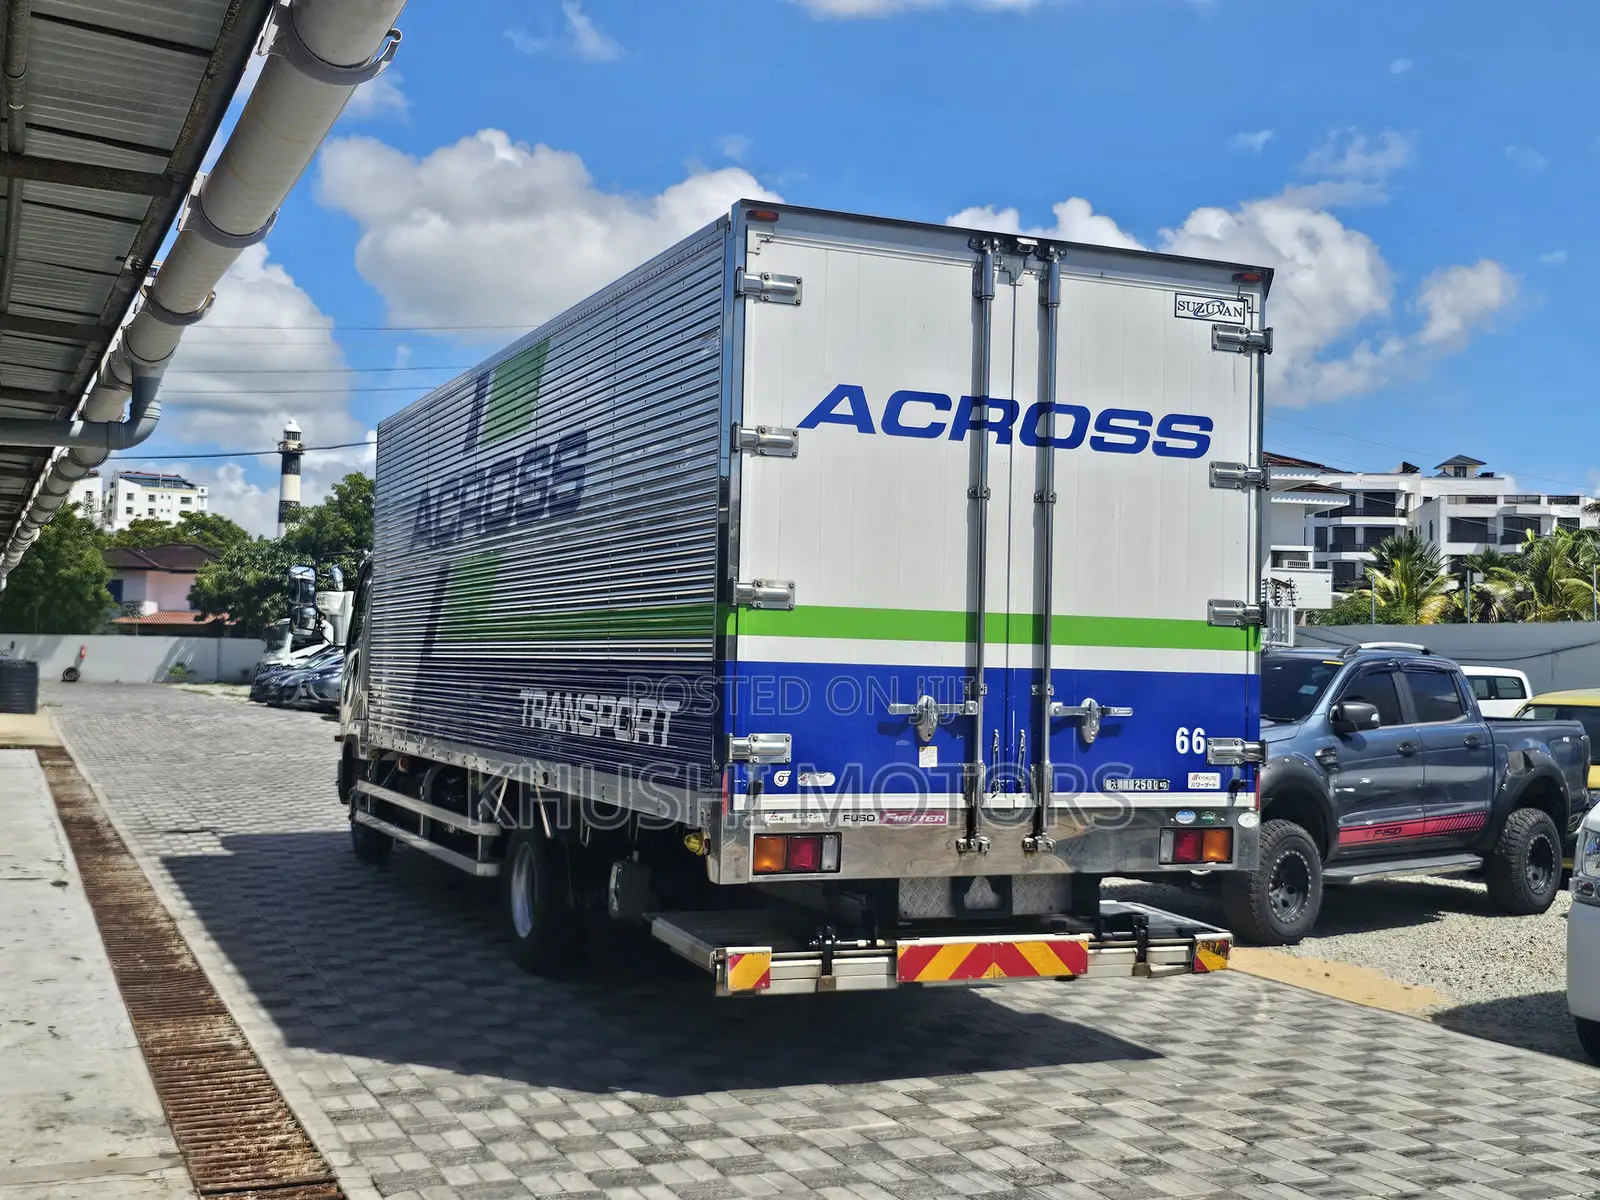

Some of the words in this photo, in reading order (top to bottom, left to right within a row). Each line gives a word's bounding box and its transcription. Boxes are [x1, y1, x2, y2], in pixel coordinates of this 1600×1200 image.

[1177, 300, 1243, 317] SUZUVAN
[797, 384, 1214, 459] ACROSS
[410, 428, 588, 552] ACROSS
[519, 687, 681, 748] TRANSPORT
[1175, 726, 1206, 755] 66
[843, 813, 876, 823] FUSO
[1372, 827, 1403, 838] F-150
